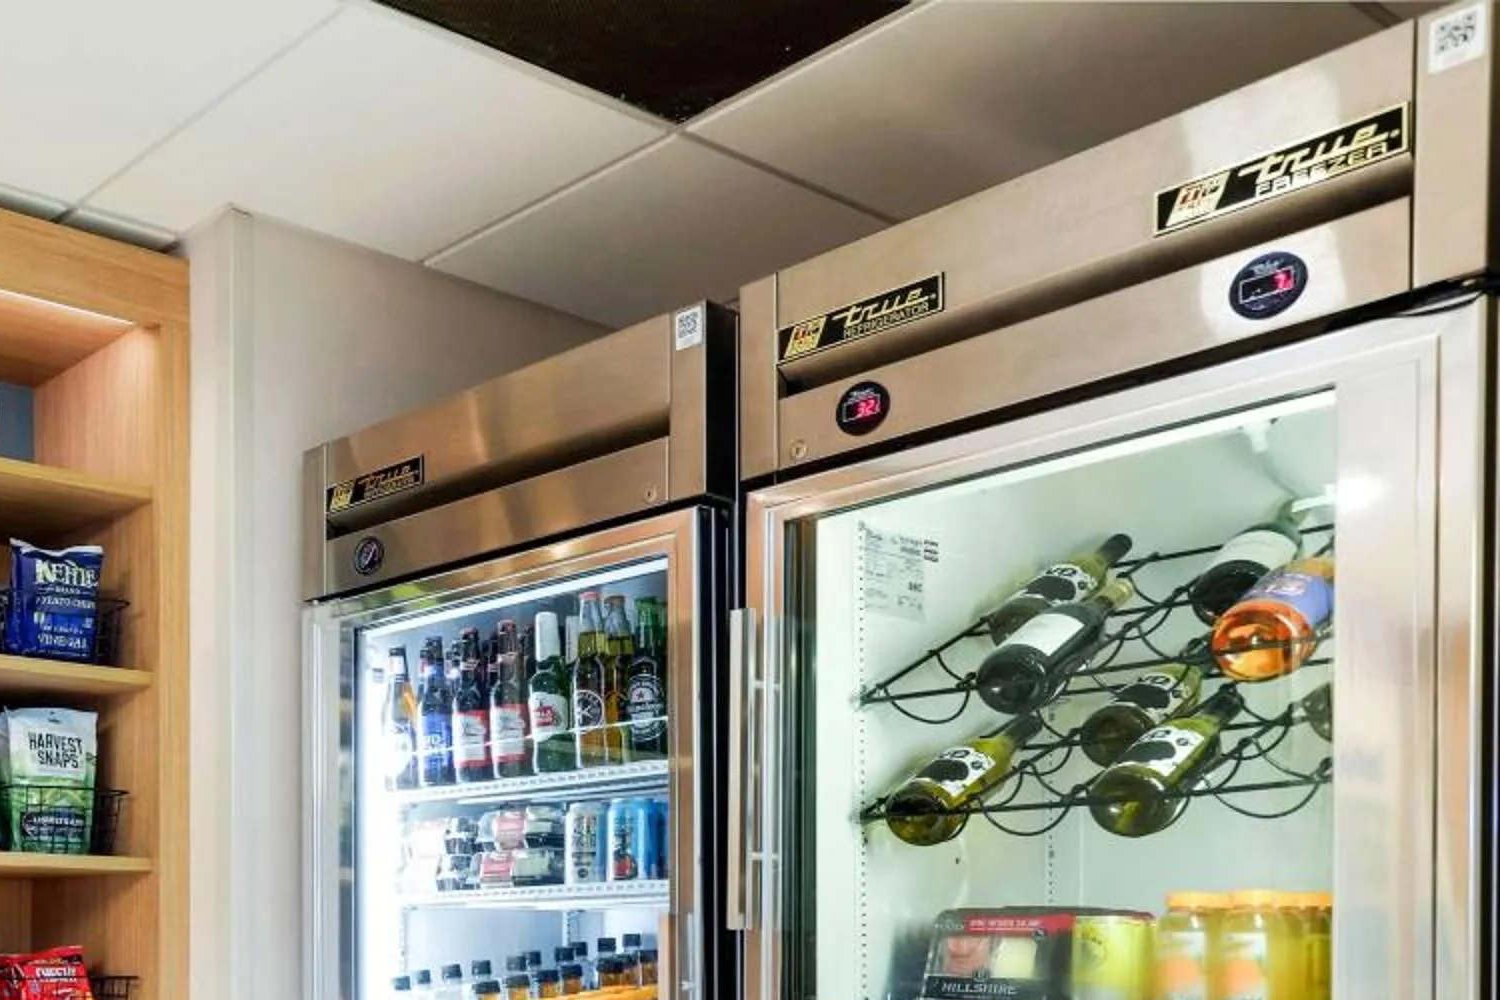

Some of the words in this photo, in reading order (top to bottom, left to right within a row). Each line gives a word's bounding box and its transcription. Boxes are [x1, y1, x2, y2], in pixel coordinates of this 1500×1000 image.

[1255, 142, 1388, 198] FREEZER
[28, 731, 83, 755] HARVEST
[37, 750, 79, 770] SNAPS
[941, 983, 1019, 995] HILLSHIRE
